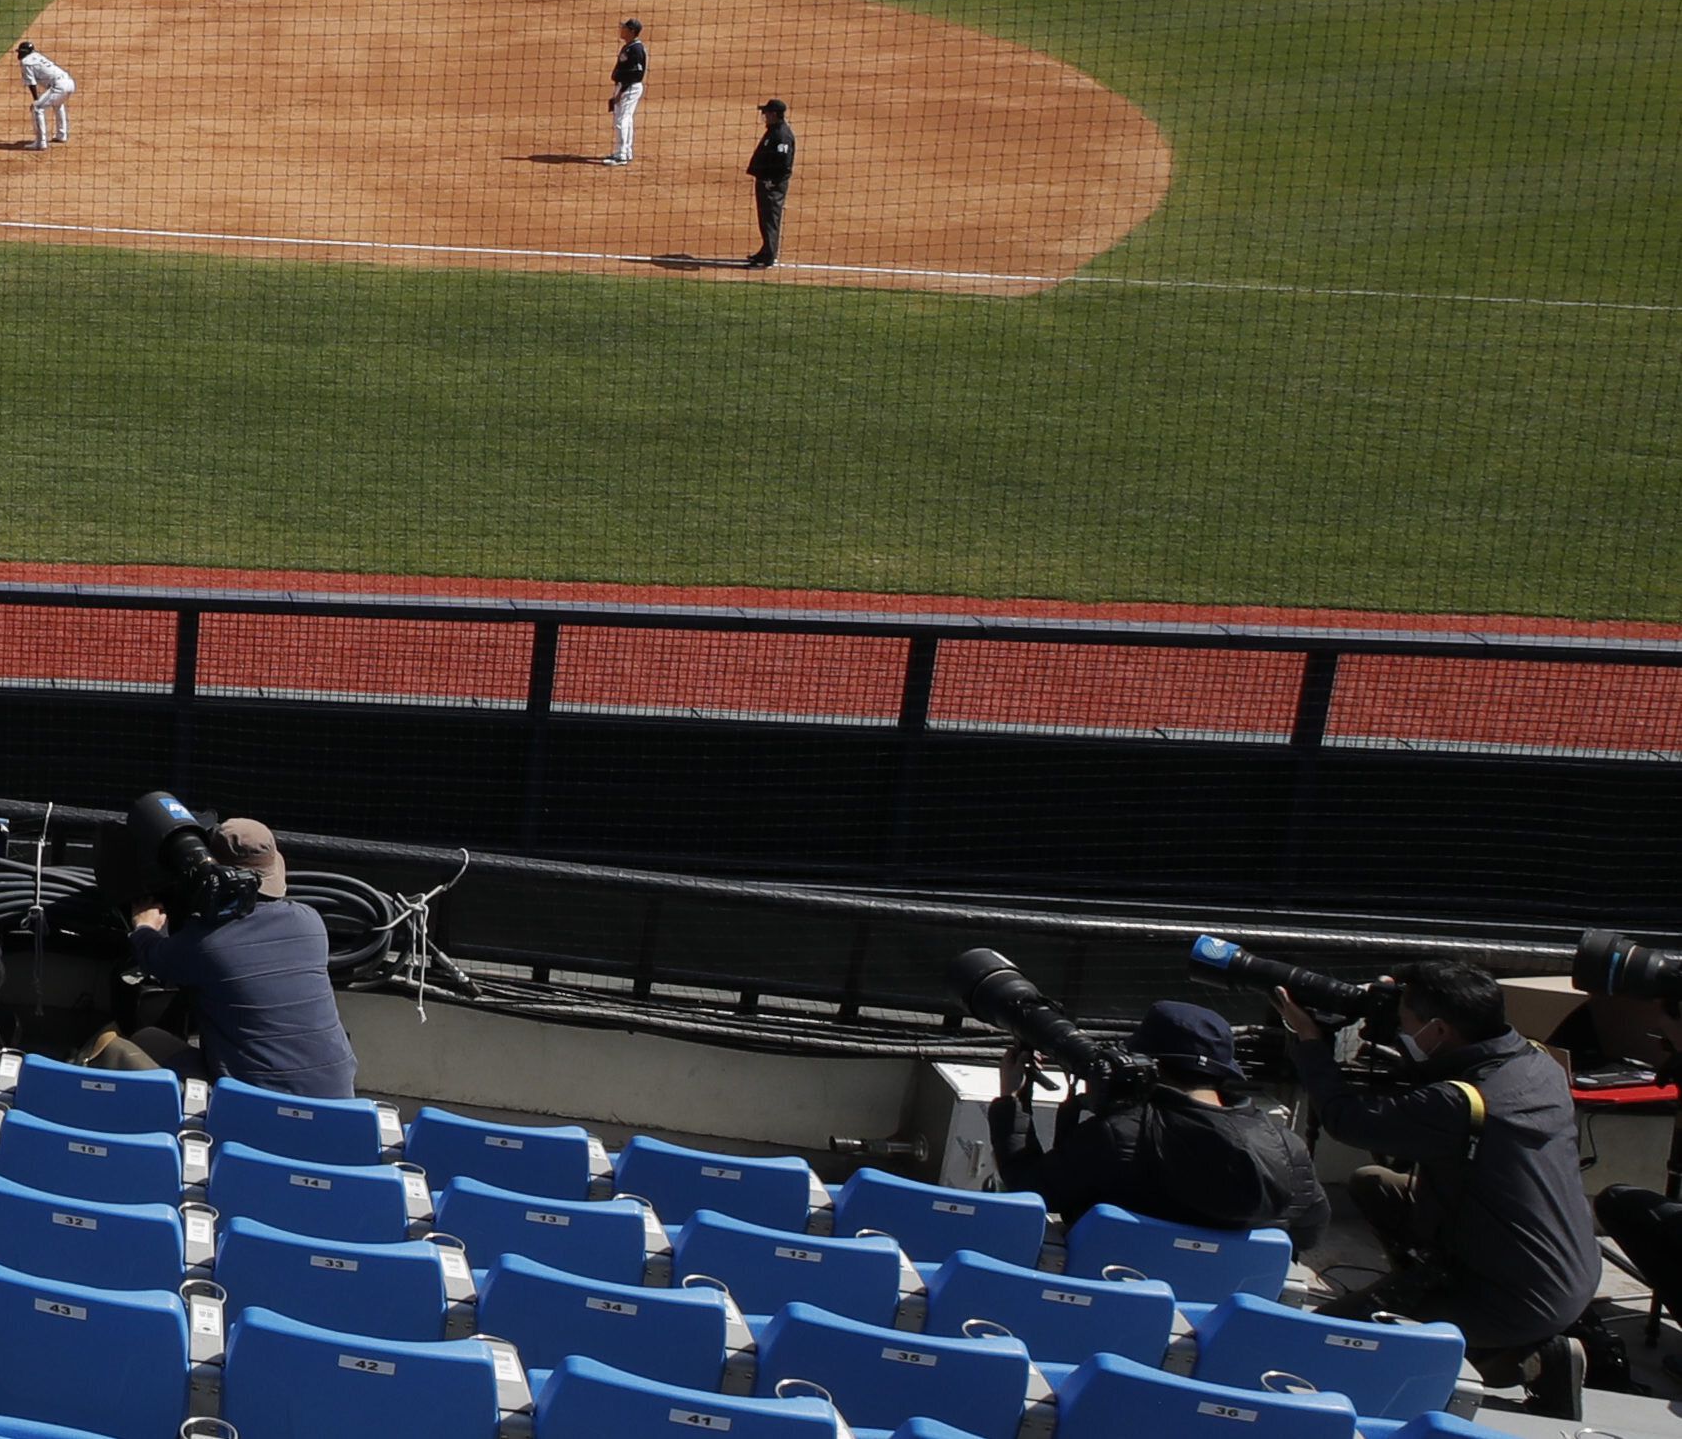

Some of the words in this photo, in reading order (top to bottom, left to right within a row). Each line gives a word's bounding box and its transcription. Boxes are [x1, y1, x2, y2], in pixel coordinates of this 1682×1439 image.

[66, 1217, 83, 1226] 32
[50, 1305, 70, 1315] 43
[602, 1302, 621, 1311] 34
[1343, 1339, 1363, 1347] 10
[899, 1353, 919, 1361] 35
[355, 1361, 378, 1371] 42
[1215, 1407, 1238, 1417] 36
[687, 1415, 711, 1426] 41
